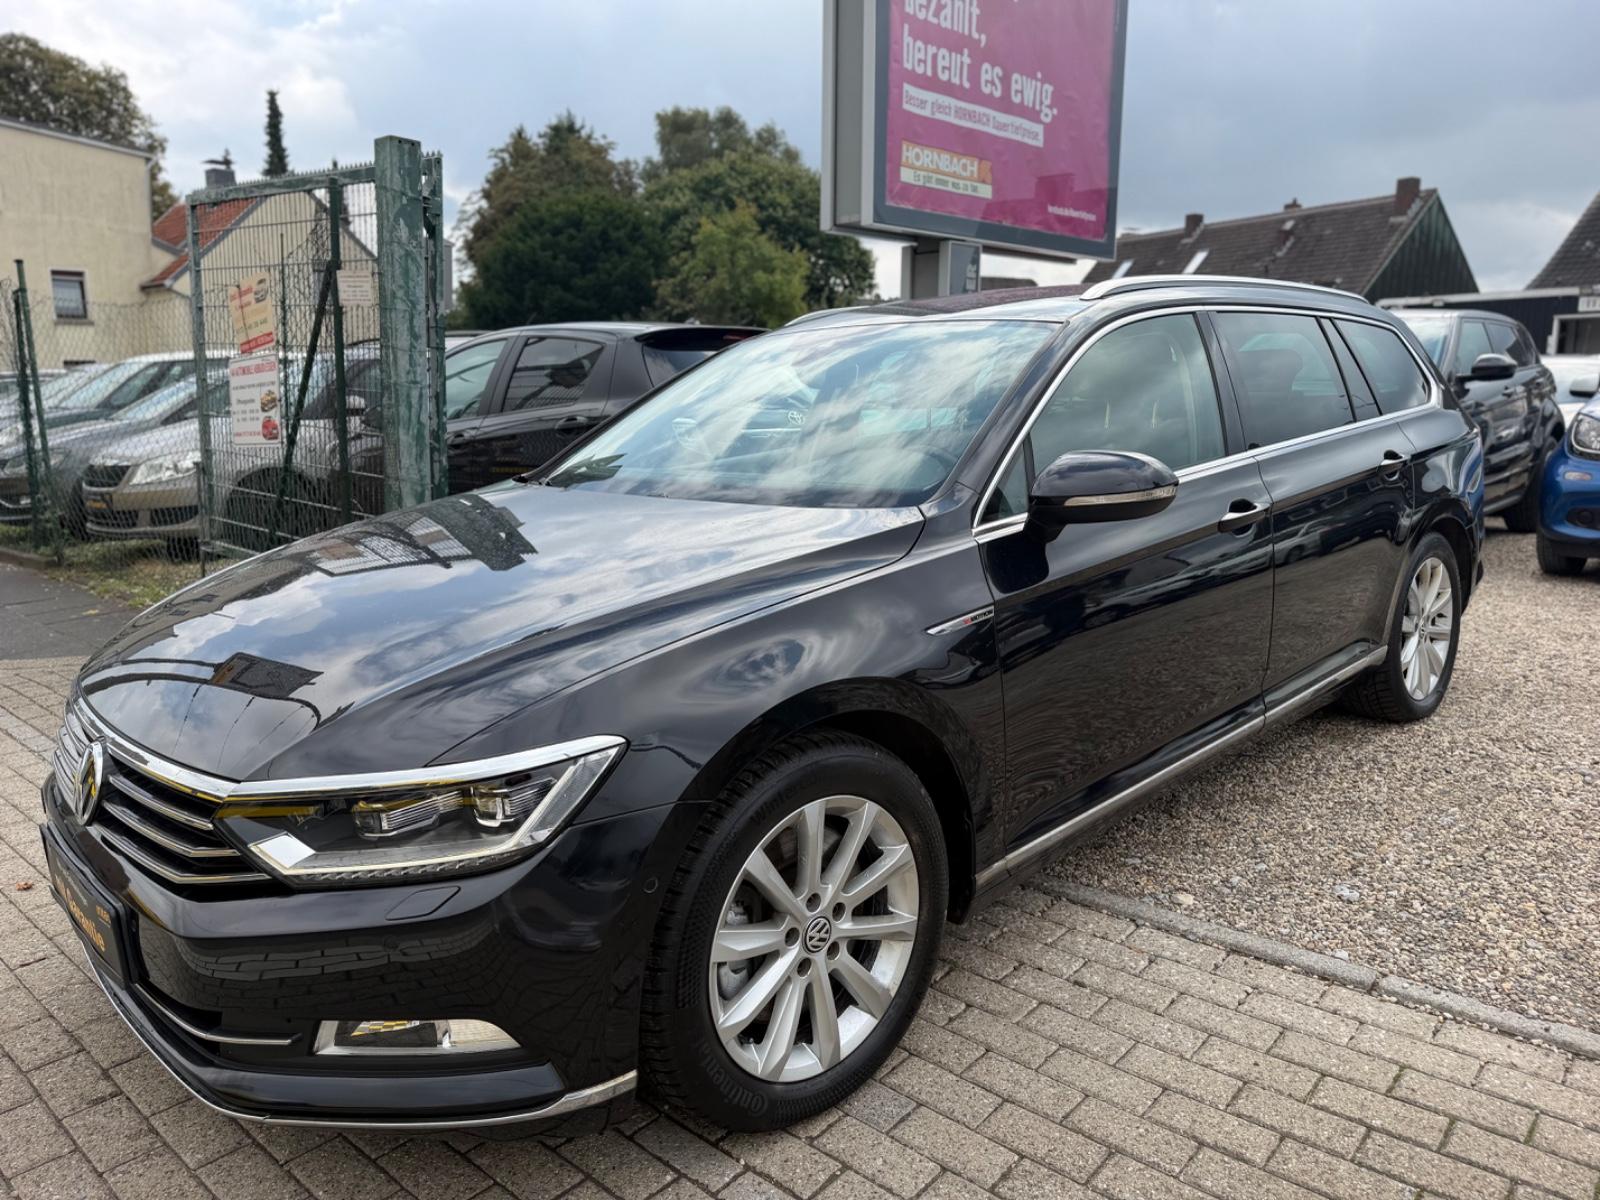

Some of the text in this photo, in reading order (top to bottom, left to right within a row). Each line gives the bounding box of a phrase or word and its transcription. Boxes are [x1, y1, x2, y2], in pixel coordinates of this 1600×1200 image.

[903, 23, 1058, 123] bereut es ewig.
[902, 143, 979, 179] HORNBACH
